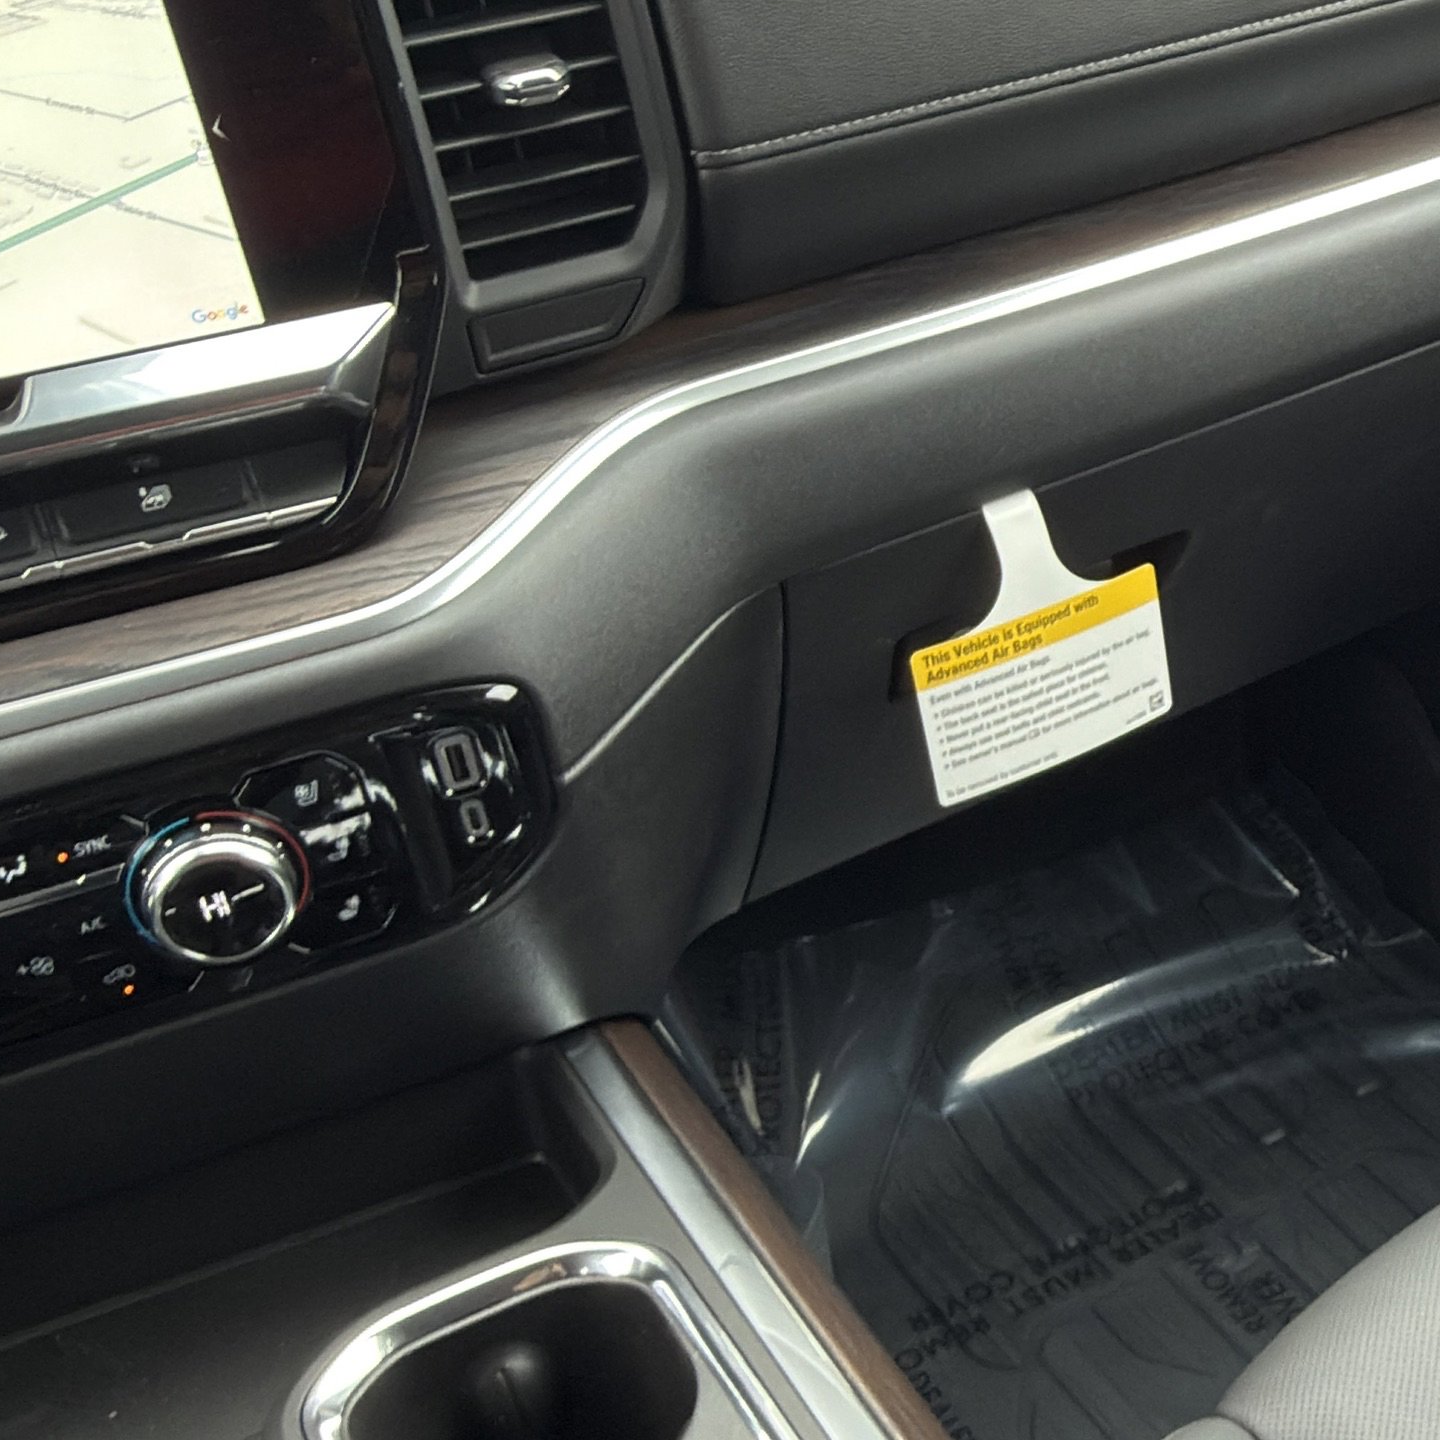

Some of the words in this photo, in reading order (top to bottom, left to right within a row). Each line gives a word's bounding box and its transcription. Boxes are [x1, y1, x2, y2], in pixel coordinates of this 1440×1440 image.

[191, 301, 248, 323] Google
[921, 651, 950, 668] This
[952, 634, 999, 657] Vehicle
[1002, 628, 1013, 641] is
[1015, 604, 1070, 635] Equipped
[1073, 595, 1098, 612] with
[927, 652, 988, 683] Advanced
[992, 646, 1008, 661] Air
[1012, 634, 1042, 653] Bags
[974, 668, 1014, 689] Advanced
[1016, 664, 1027, 673] Air
[1029, 655, 1050, 669] Bags
[72, 834, 110, 858] SYNC
[199, 891, 231, 924] HI
[80, 916, 105, 934] A/C
